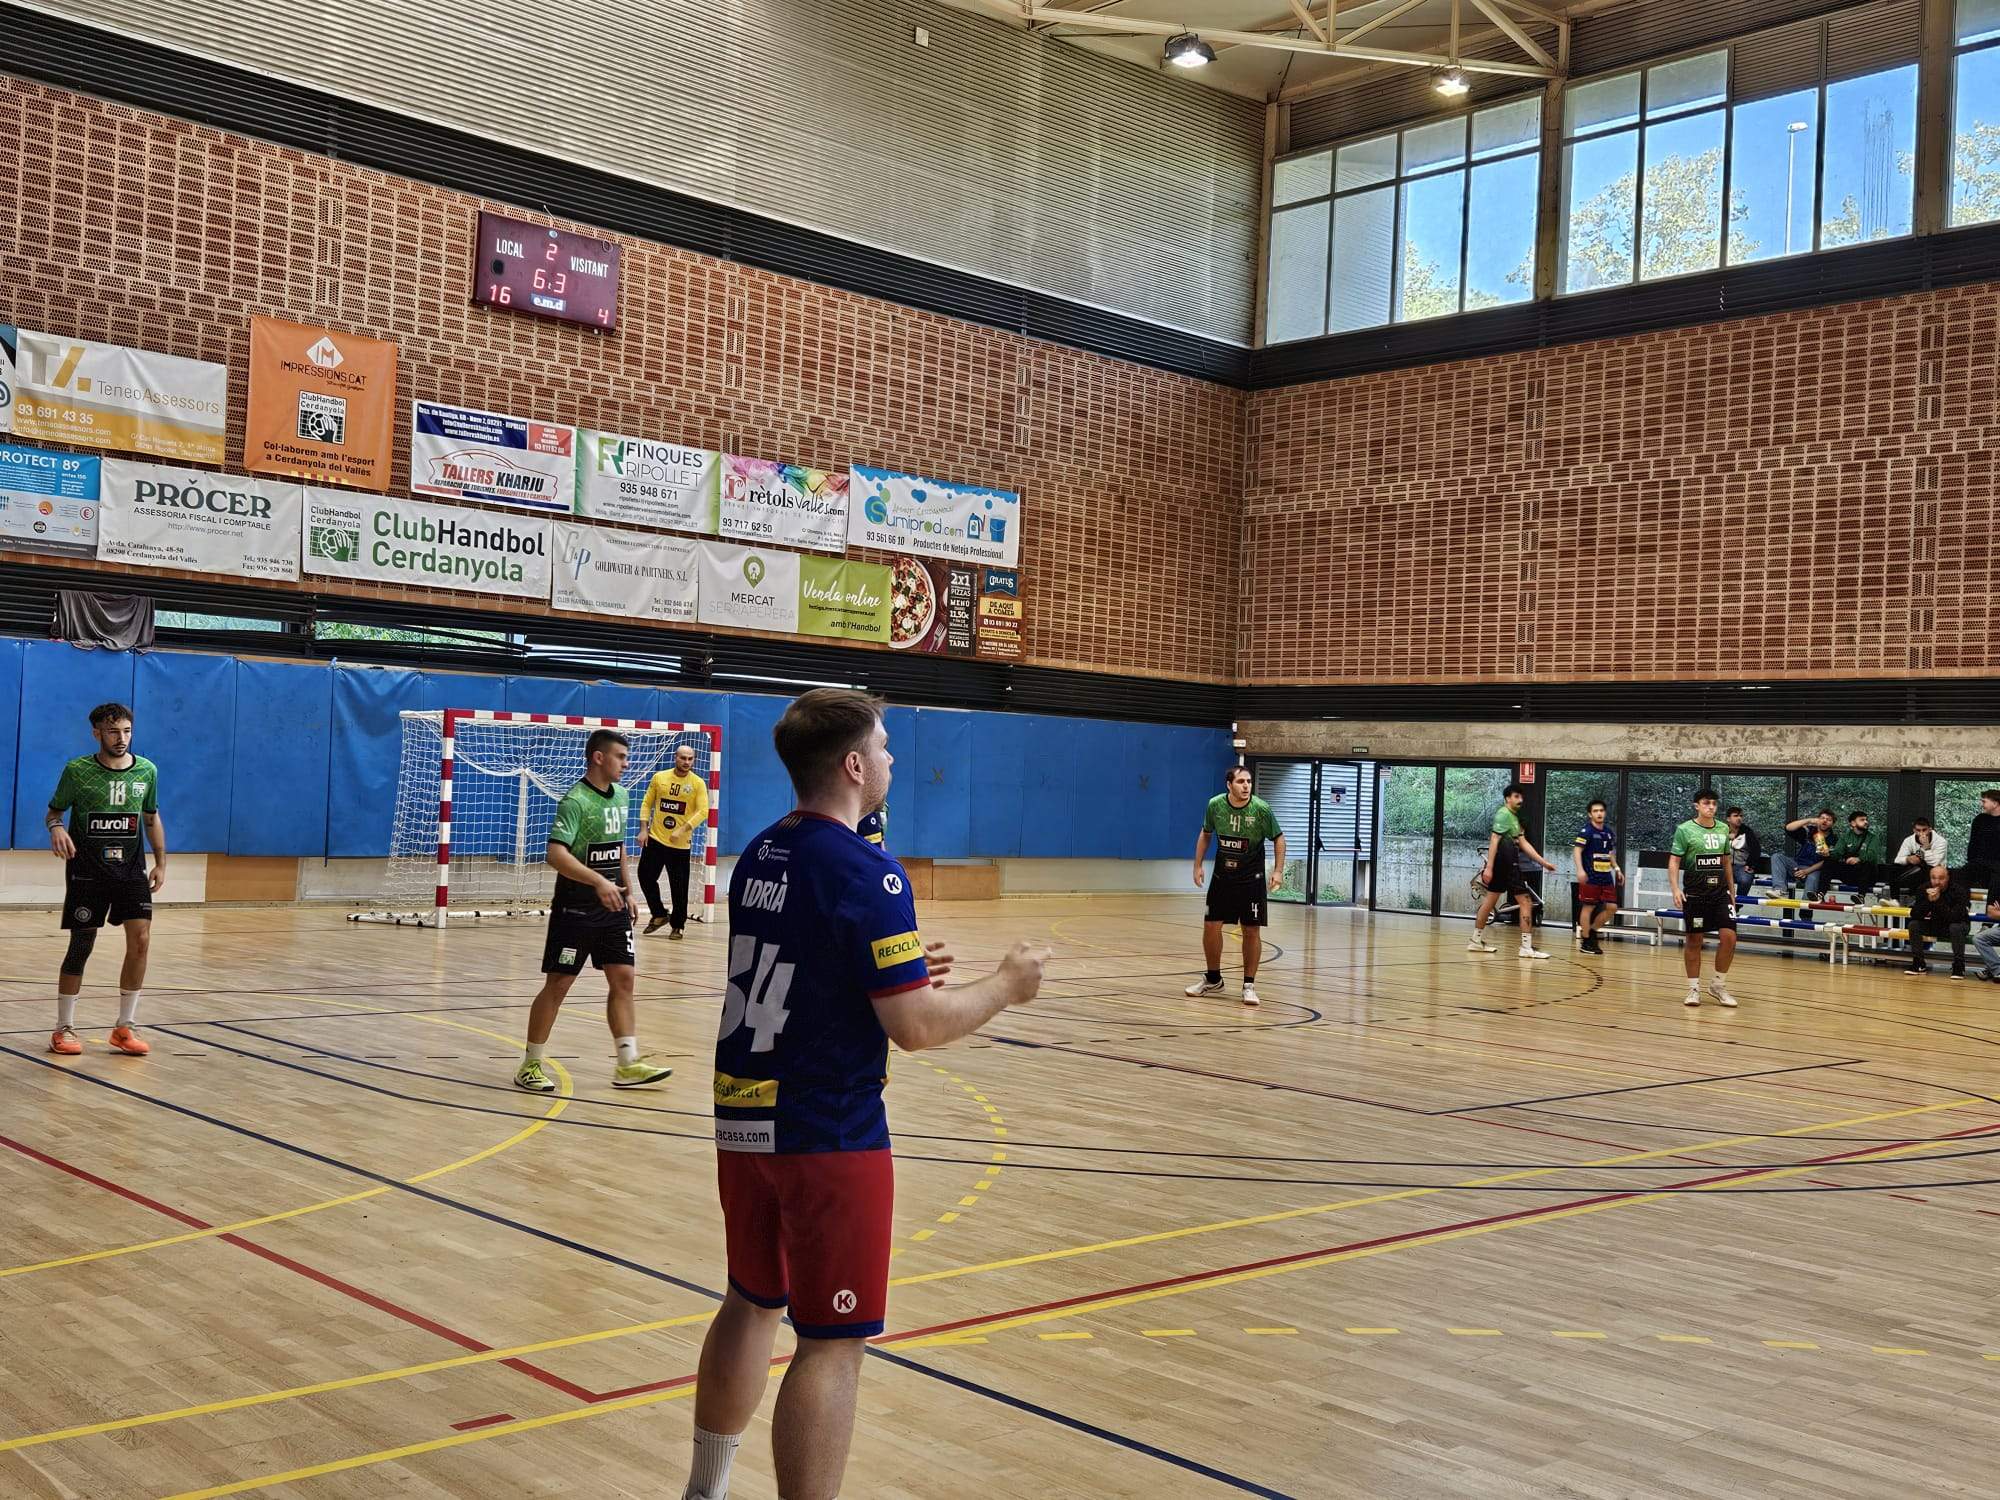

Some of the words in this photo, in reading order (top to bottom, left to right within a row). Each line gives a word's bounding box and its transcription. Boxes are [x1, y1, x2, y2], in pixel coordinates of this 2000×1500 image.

[496, 238, 525, 259] LOCAL
[546, 243, 558, 261] 2
[570, 255, 609, 278] VISITANT
[489, 284, 511, 304] 16
[598, 308, 609, 325] 4
[97, 379, 220, 414] TeneoAssessors
[301, 392, 345, 407] ClubHandbol
[18, 403, 33, 416] 93
[37, 405, 57, 419] 691
[62, 410, 77, 422] 43
[79, 412, 94, 425] 35
[300, 400, 345, 415] Cerdanyola
[0, 451, 57, 468] ROTECT
[62, 459, 80, 471] 89
[266, 453, 272, 461] a
[274, 453, 326, 472] Cerdanyola
[328, 461, 342, 472] del
[320, 450, 339, 461] amb
[626, 441, 703, 468] FINQUES
[442, 463, 495, 486] TALLERS
[496, 471, 545, 493] KHARJU
[626, 461, 702, 487] RIPOLLET
[620, 482, 638, 494] 935
[640, 485, 658, 498] 948
[661, 488, 678, 501] 671
[134, 506, 187, 521] ASSESSORIA
[189, 513, 217, 526] FISCAL
[223, 518, 271, 531] COMPTABLE
[310, 505, 361, 520] ClubHandbol
[168, 522, 244, 538] http://www.procer.net
[310, 515, 361, 529] Cerdanyola
[722, 517, 733, 528] 93
[735, 519, 749, 529] 717
[752, 522, 760, 531] 62
[763, 524, 773, 533] 50
[374, 511, 545, 556] ClubHandbol
[866, 531, 875, 541] 93
[876, 533, 888, 543] 561
[127, 550, 167, 561] Cerdanyola
[913, 538, 942, 552] Productes
[943, 543, 950, 551] de
[951, 544, 969, 555] Neteja
[970, 546, 1004, 560] Professional
[372, 541, 523, 583] Cerdanyola
[595, 560, 633, 576] GOLDWATER
[634, 566, 640, 576] &
[950, 573, 970, 586] 2x1
[731, 592, 775, 607] MERCAT
[803, 577, 843, 602] Venda
[846, 582, 882, 607] online
[951, 588, 971, 597] PIZZAS
[830, 621, 847, 629] amb
[949, 639, 970, 648] TAPAS
[109, 781, 127, 805] 18
[669, 783, 681, 796] 50
[91, 817, 129, 830] nuroil
[604, 807, 621, 835] 58
[1229, 814, 1241, 832] 41
[1704, 833, 1719, 850] 36
[590, 846, 621, 862] nuroil
[1697, 856, 1721, 866] nuroil
[741, 870, 788, 913] IDRIÀ
[1251, 903, 1259, 918] 4
